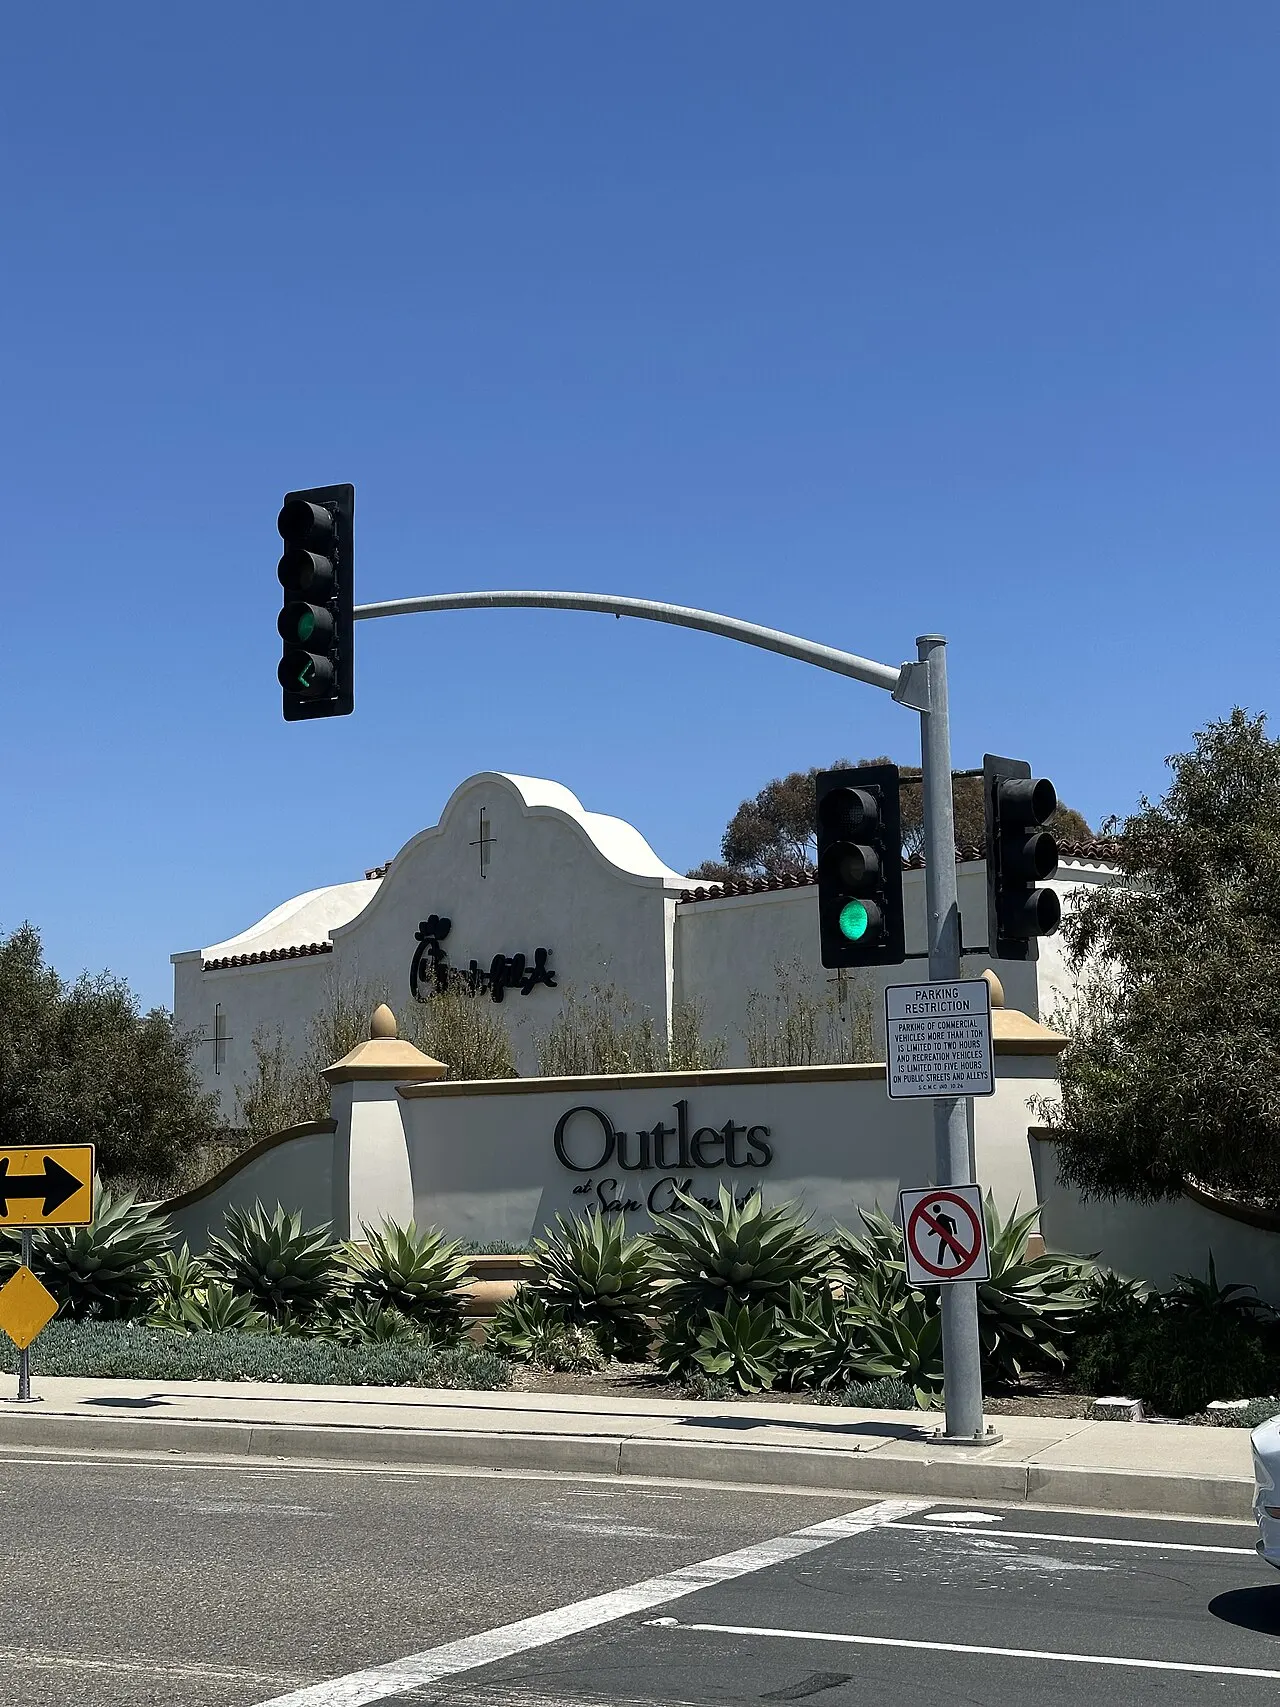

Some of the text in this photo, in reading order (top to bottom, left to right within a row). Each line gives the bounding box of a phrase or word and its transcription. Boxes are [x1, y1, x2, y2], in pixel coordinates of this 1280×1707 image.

[916, 988, 958, 1000] PARKING
[906, 1000, 970, 1013] RESTRICTION
[899, 1023, 925, 1032] PARKING
[938, 1020, 978, 1029] COMMERCIAL
[895, 1030, 983, 1042] VEHICLES MORE THAN 1 TON
[907, 1043, 931, 1052] LIMITED
[934, 1042, 941, 1050] TO
[944, 1041, 956, 1049] TWO
[960, 1040, 980, 1049] HOURS
[897, 1051, 983, 1062] AND RECREATION VEHICLES
[899, 1065, 904, 1073] IS
[907, 1063, 931, 1072] LIMITED
[944, 1062, 958, 1070] FIVE
[961, 1061, 982, 1069] HOURS
[904, 1074, 925, 1083] PUBLIC
[926, 1073, 950, 1082] STREETS
[952, 1072, 964, 1080] AND
[967, 1071, 988, 1080] ALLEYS
[554, 1100, 773, 1172] Outlets
[572, 1178, 592, 1194] at
[584, 1178, 642, 1215] San
